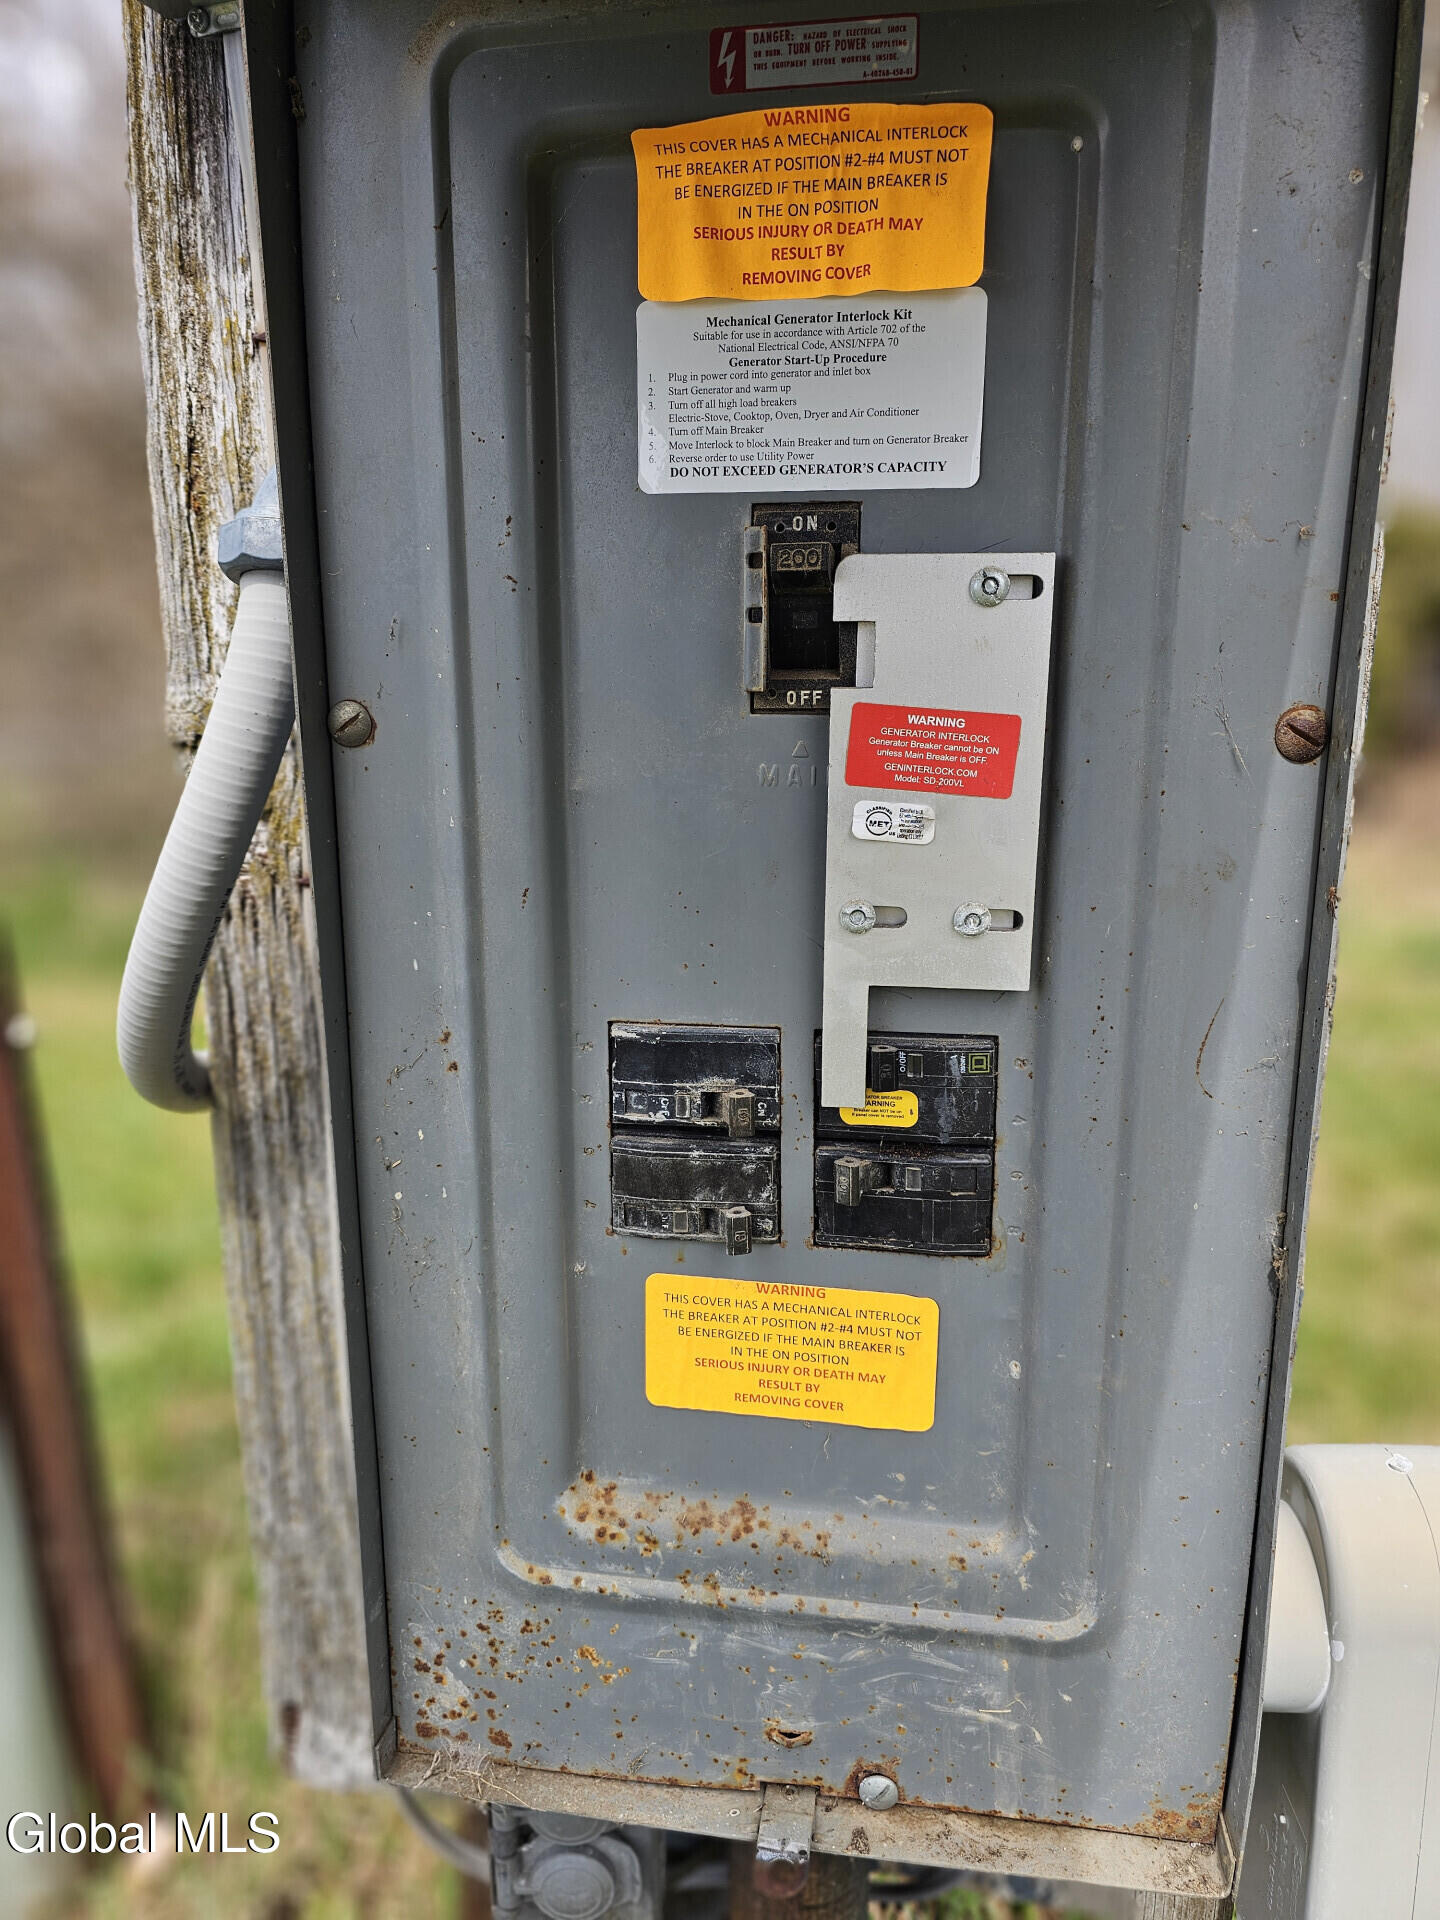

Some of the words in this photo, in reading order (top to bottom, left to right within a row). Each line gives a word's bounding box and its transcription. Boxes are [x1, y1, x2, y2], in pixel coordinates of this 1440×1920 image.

[754, 30, 794, 44] DANGER:
[888, 25, 906, 33] SHOCK
[788, 43, 810, 56] TURN
[815, 40, 830, 52] OFF
[835, 38, 866, 51] POWER
[764, 107, 850, 126] WARNING
[654, 142, 685, 156] THIS
[690, 138, 737, 152] COVER
[742, 136, 769, 149] HAS
[774, 135, 784, 148] A
[788, 129, 883, 146] MECHANICAL
[888, 126, 968, 140] INTERLOCK
[655, 164, 682, 179] THE
[687, 160, 748, 176] BREAKER
[752, 159, 771, 173] AT
[776, 154, 840, 172] POSITION
[844, 152, 884, 168] #2-#4
[890, 150, 934, 164] MUST
[937, 148, 969, 163] NOT
[675, 185, 690, 200] BE
[695, 182, 772, 198] ENERGIZED
[778, 181, 789, 194] IF
[792, 180, 820, 194] THE
[824, 177, 862, 192] MAIN
[868, 173, 930, 190] BREAKER
[936, 173, 948, 186] IS
[694, 227, 754, 241] SERIOUS
[758, 224, 809, 239] INJURY
[813, 222, 832, 236] OR
[837, 217, 884, 235] DEATH
[889, 217, 923, 230] MAY
[743, 269, 821, 285] REMOVING
[826, 264, 870, 280] COVER
[706, 315, 770, 328] Mechanical
[774, 313, 834, 325] Generator
[836, 310, 890, 322] Interlock
[894, 309, 912, 320] Kit
[693, 331, 728, 341] Suitable
[731, 330, 743, 340] for
[763, 329, 771, 338] in
[774, 328, 822, 338] accordance
[826, 326, 844, 335] with
[847, 325, 878, 335] Article
[881, 324, 896, 334] 702
[900, 324, 911, 333] of
[912, 323, 925, 332] the
[718, 343, 754, 353] National
[758, 341, 798, 351] Electrical
[802, 340, 827, 350] Code,
[829, 338, 885, 349] ANSI/NFPA
[888, 337, 898, 346] 70
[729, 357, 782, 367] Generator
[784, 354, 830, 366] Start-Up
[834, 352, 887, 363] Procedure
[668, 372, 688, 383] Plug
[690, 372, 698, 380] in
[701, 374, 727, 383] power
[730, 370, 748, 379] cord
[752, 370, 768, 379] into
[771, 370, 812, 380] generator
[814, 367, 830, 376] and
[832, 367, 852, 376] inlet
[855, 366, 870, 375] box
[668, 387, 688, 396] Start
[691, 386, 733, 395] Generator
[736, 384, 750, 393] and
[780, 386, 791, 394] up
[669, 441, 692, 450] Move
[696, 440, 733, 449] Interlock
[747, 439, 770, 448] block
[773, 438, 795, 447] Main
[798, 437, 832, 446] Breaker
[834, 436, 850, 445] and
[887, 435, 931, 444] Generator
[934, 434, 968, 443] Breaker
[670, 467, 689, 478] DO
[692, 466, 719, 477] NOT
[723, 465, 776, 476] EXCEED
[878, 461, 947, 473] CAPACITY
[792, 515, 818, 531] ON
[779, 548, 819, 567] 200
[786, 690, 822, 706] OFF
[908, 714, 966, 728] WARNING
[881, 727, 936, 739] GENERATOR
[938, 732, 990, 743] INTERLOCK
[869, 737, 909, 747] Generator
[910, 740, 942, 750] Breaker
[973, 745, 983, 754] be
[986, 747, 999, 755] ON
[877, 749, 902, 757] unless
[904, 750, 924, 759] Main
[926, 752, 958, 762] Breaker
[758, 763, 830, 787] MAI
[884, 762, 978, 778] GENINTERLOCK.COM
[894, 774, 921, 783] Model:
[923, 776, 964, 787] SD-200VL
[866, 1100, 896, 1108] ARNING
[756, 1283, 826, 1298] WARNING
[664, 1293, 688, 1304] THIS
[693, 1296, 731, 1308] COVER
[736, 1299, 758, 1309] HAS
[761, 1302, 769, 1310] A
[774, 1302, 852, 1318] MECHANICAL
[856, 1310, 920, 1325] INTERLOCK
[662, 1309, 684, 1319] THE
[688, 1312, 739, 1324] BREAKER
[743, 1316, 758, 1326] AT
[762, 1317, 816, 1330] POSITION
[821, 1322, 853, 1334] #2-#4
[858, 1325, 892, 1338] MUST
[896, 1329, 922, 1341] NOT
[678, 1326, 692, 1336] BE
[696, 1328, 759, 1342] ENERGIZED
[764, 1333, 772, 1342] IF
[776, 1334, 798, 1345] THE
[802, 1336, 834, 1348] MAIN
[839, 1340, 891, 1354] BREAKER
[896, 1346, 904, 1356] IS
[695, 1358, 744, 1370] SERIOUS
[748, 1362, 789, 1374] INJURY
[793, 1367, 810, 1376] OR
[814, 1368, 854, 1380] DEATH
[858, 1372, 886, 1384] MAY
[735, 1392, 800, 1407] REMOVING
[804, 1399, 844, 1411] COVER
